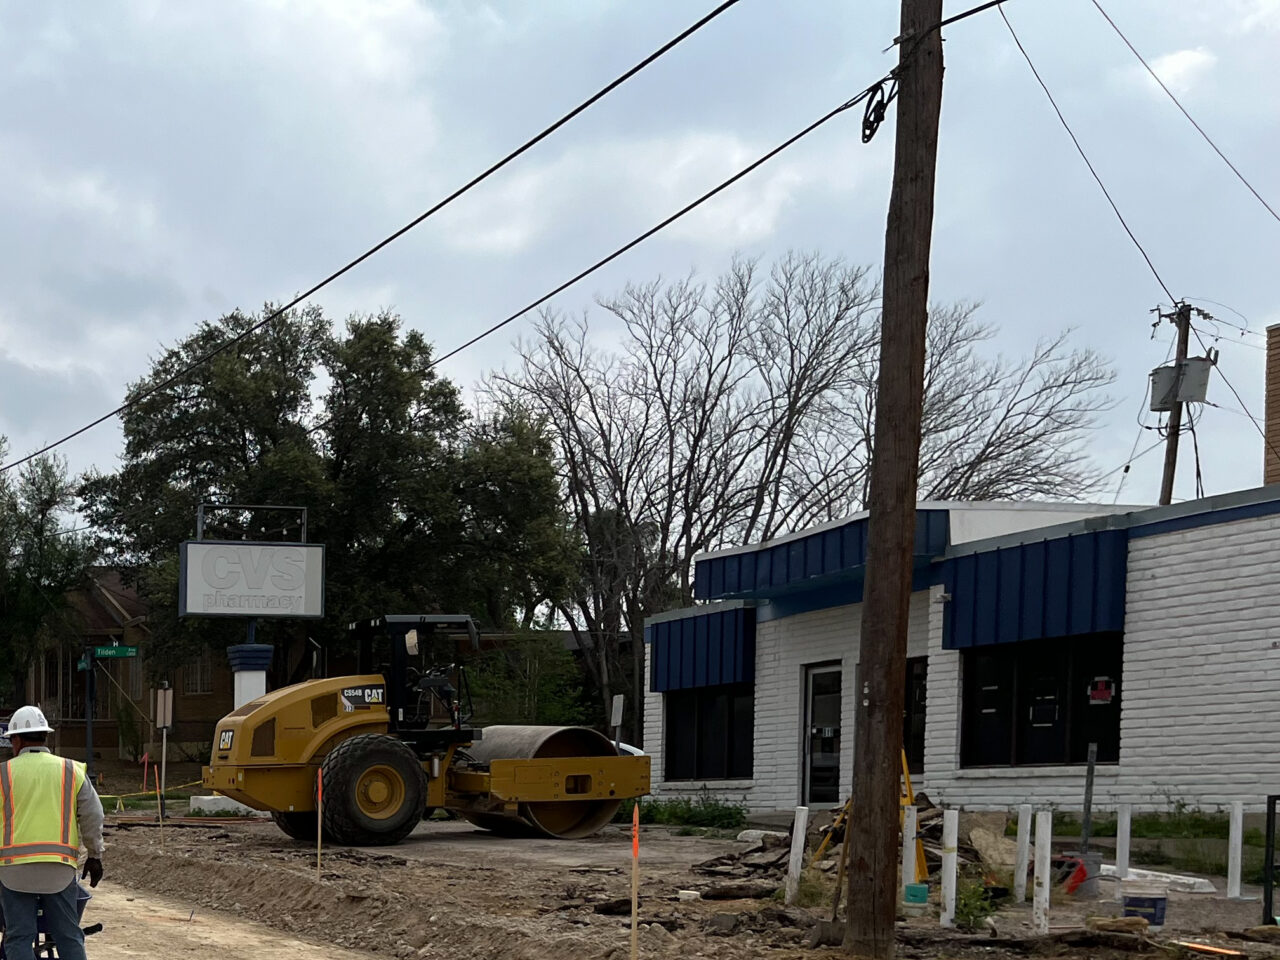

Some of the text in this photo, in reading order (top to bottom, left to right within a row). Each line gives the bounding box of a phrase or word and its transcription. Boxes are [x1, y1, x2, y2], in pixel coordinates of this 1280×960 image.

[202, 546, 305, 591] CVS
[202, 591, 302, 614] pharmacy
[97, 648, 116, 656] Tilden
[364, 689, 383, 702] CAT
[220, 731, 233, 749] CAT
